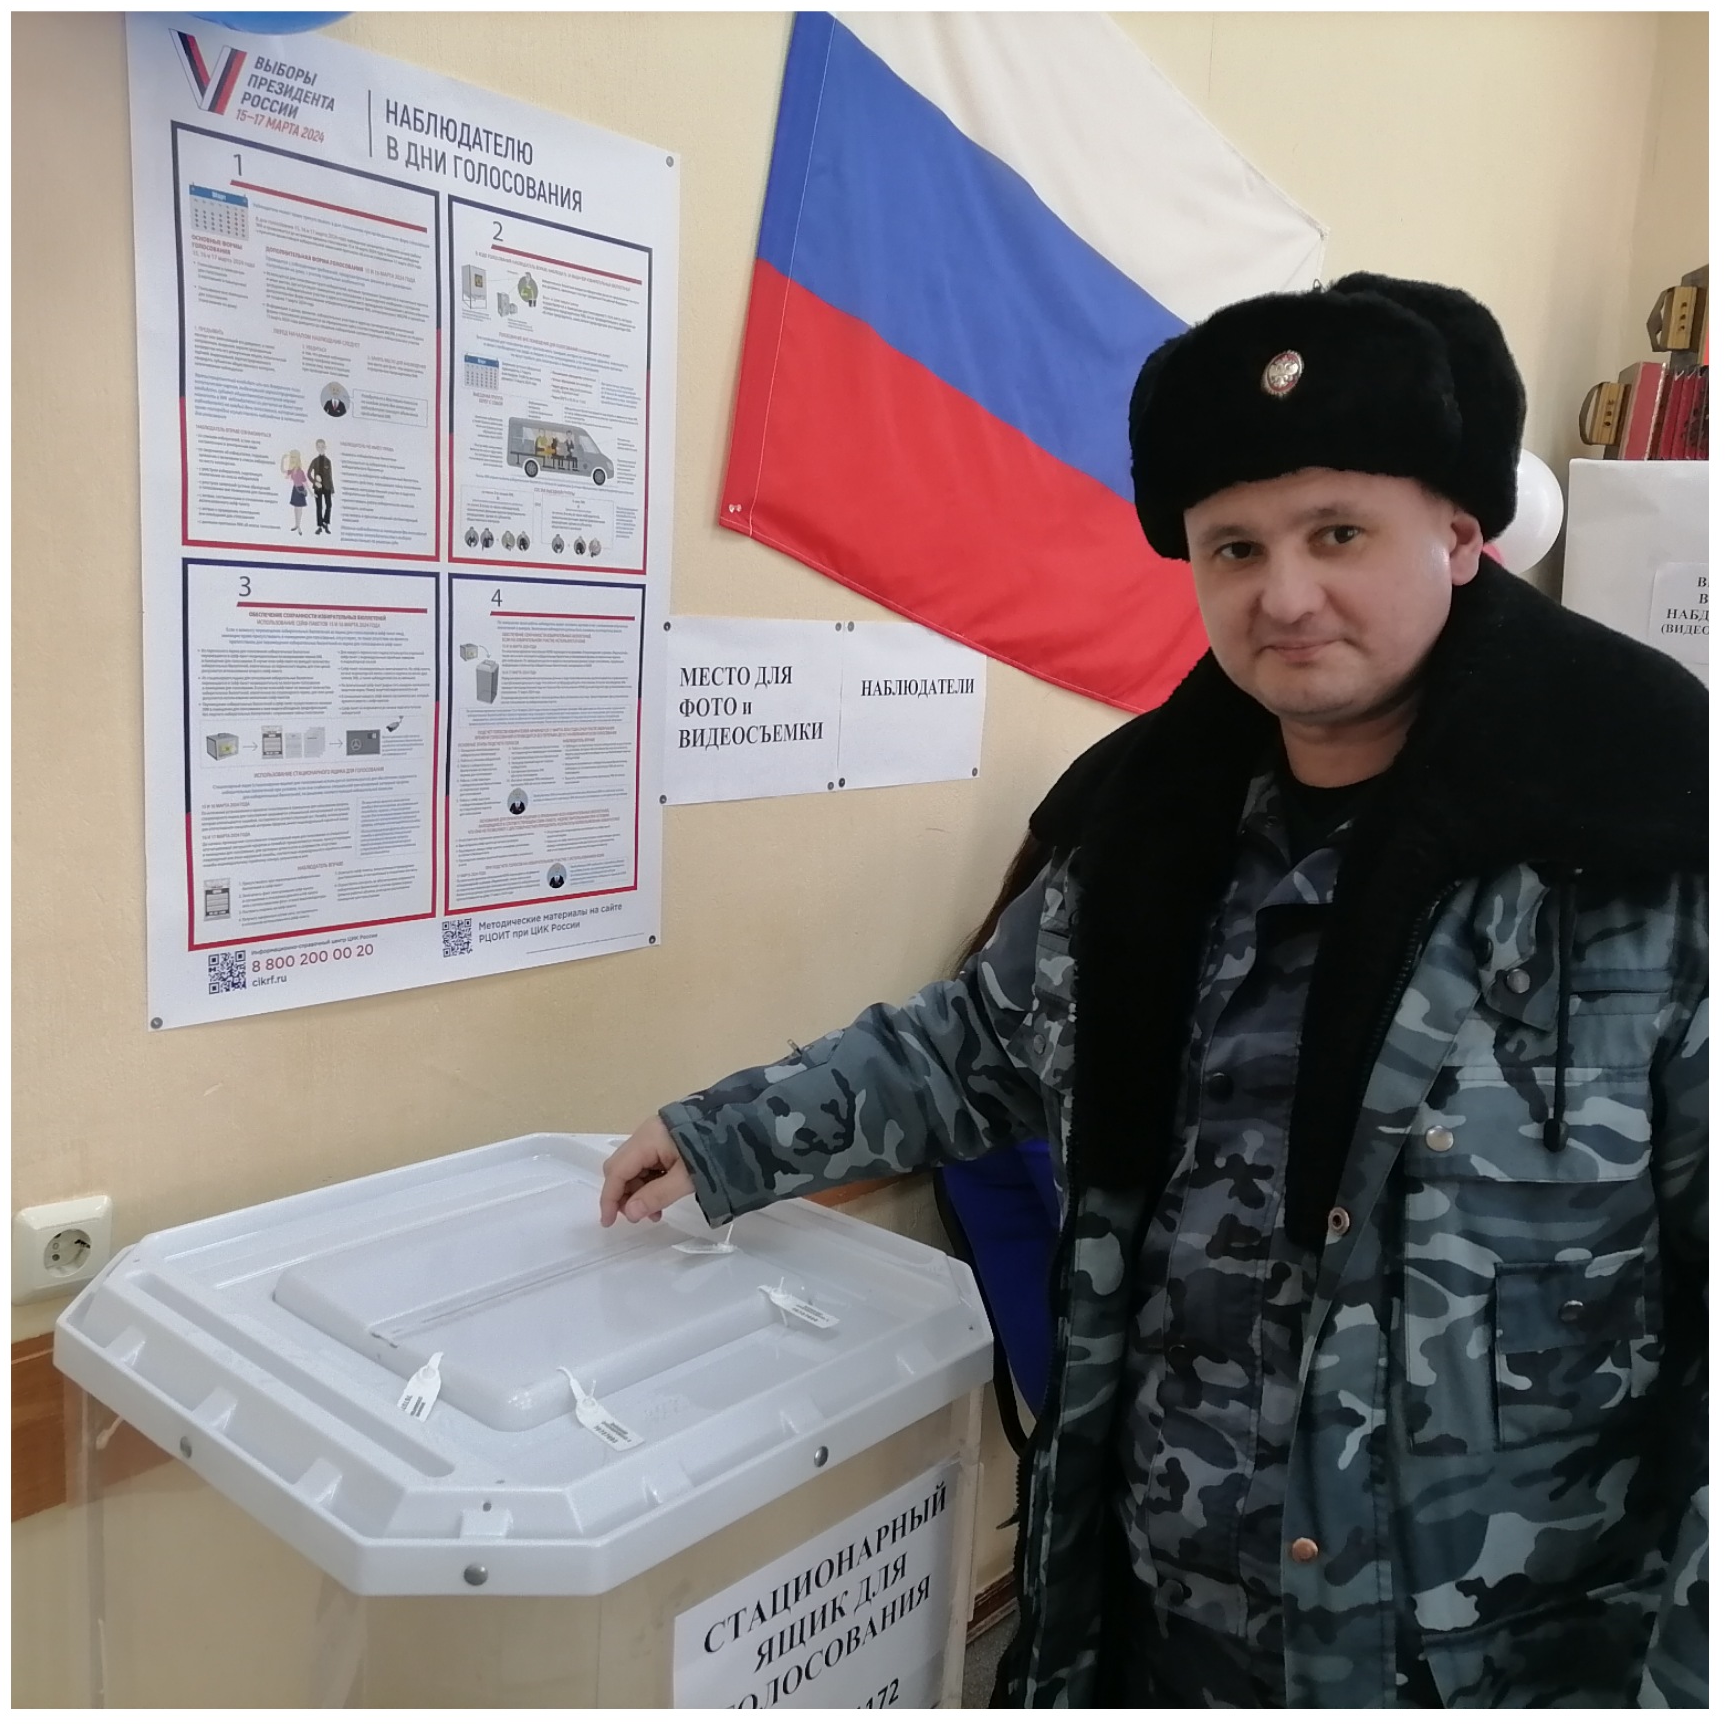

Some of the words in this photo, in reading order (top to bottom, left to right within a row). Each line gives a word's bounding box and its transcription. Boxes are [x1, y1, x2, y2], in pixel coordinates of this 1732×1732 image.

[254, 55, 318, 86] ВЫБОРЫ
[240, 92, 298, 120] РОССИИ
[247, 73, 335, 112] ПРЕЗИДЕНТА
[265, 116, 300, 137] МАРТА
[301, 125, 324, 144] 2024
[386, 98, 533, 166] НАБЛЮДАТЕЛЮ
[233, 154, 243, 176] 1
[387, 135, 398, 160] В
[405, 140, 447, 175] ДНИ
[453, 154, 582, 213] ГОЛОСОВАНИЯ
[492, 220, 504, 242] 2
[238, 576, 251, 597] 3
[491, 588, 503, 607] 4
[679, 666, 750, 687] МЕСТО
[754, 665, 793, 688] ДЛЯ
[861, 678, 975, 699] НАБЛЮДАТЕЛИ
[679, 697, 737, 718] ФОТО
[742, 701, 752, 715] и
[678, 721, 824, 750] ВИДЕОСЪЕМКИ
[478, 916, 541, 930] Методические
[544, 908, 587, 925] материалы
[601, 903, 622, 912] сайте
[479, 930, 510, 944] РЦОИТ
[513, 928, 528, 939] при
[531, 924, 549, 936] ЦИК
[551, 920, 580, 932] России
[252, 960, 261, 972] 8
[265, 955, 295, 970] 800
[300, 950, 328, 965] 200
[333, 947, 352, 960] 00
[357, 944, 374, 957] 20
[252, 974, 287, 987] cikrf.ru
[704, 1481, 946, 1654] СТАЦИОНАРНЫЙ
[753, 1589, 848, 1673] ЯЩИК
[854, 1551, 907, 1616] ДЛЯ
[726, 1574, 931, 1708] ОЛОСОВАНИЯ
